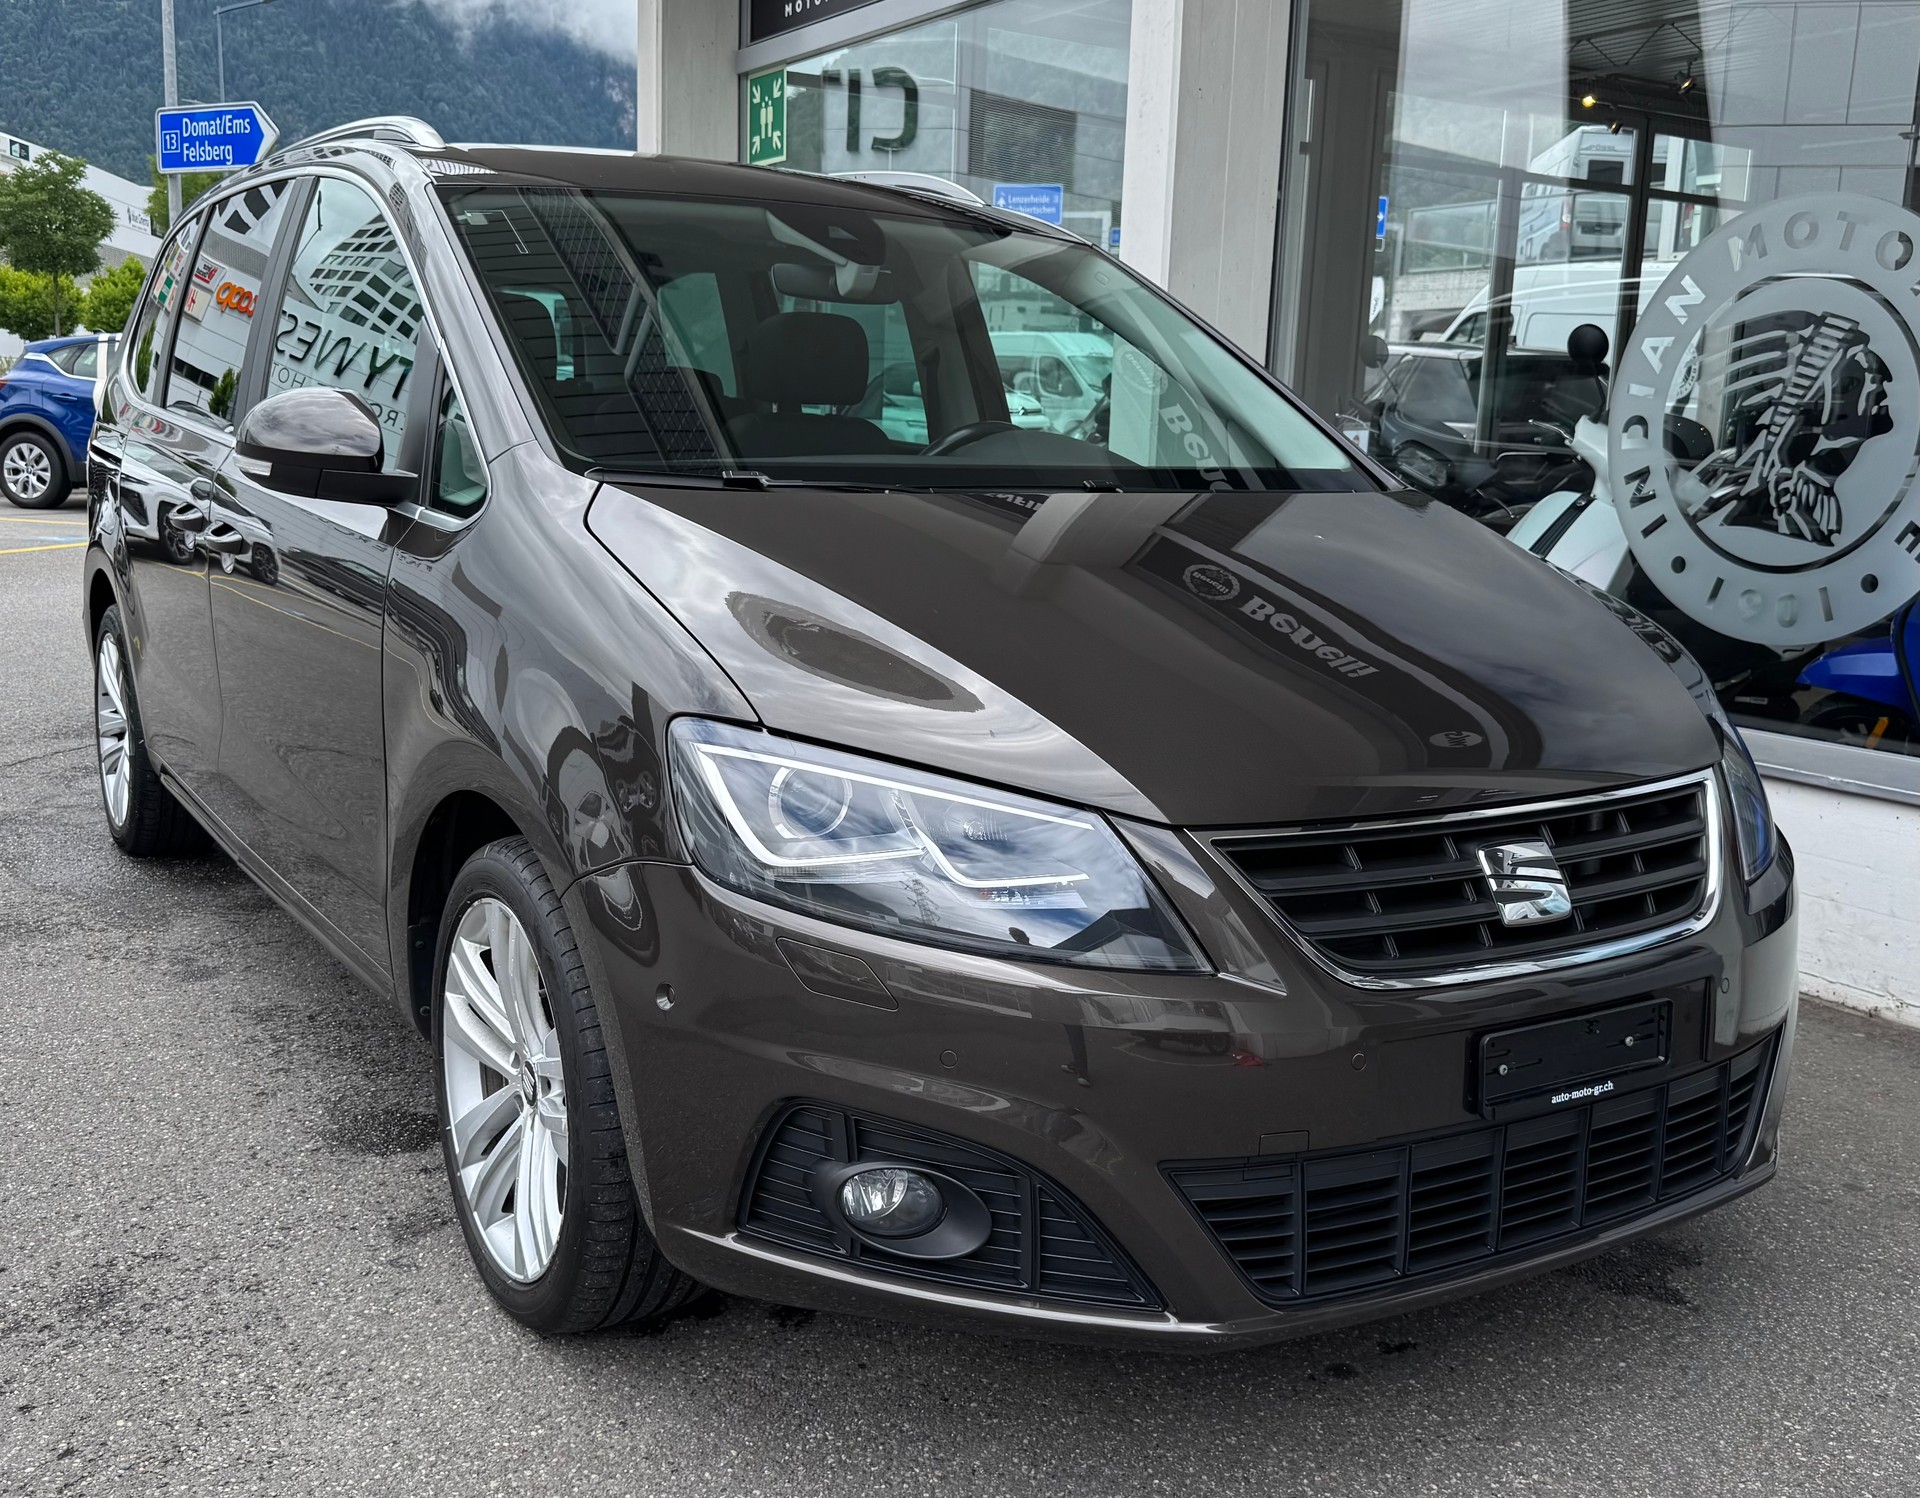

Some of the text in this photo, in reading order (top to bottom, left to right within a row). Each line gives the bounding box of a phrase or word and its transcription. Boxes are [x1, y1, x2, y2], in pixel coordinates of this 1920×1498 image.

[182, 115, 251, 137] Domat/Ems
[165, 134, 177, 150] 13
[183, 140, 233, 165] Felsberg
[1008, 194, 1050, 203] Lenzerheide
[1621, 211, 1920, 539] INDIAN MOTO
[1706, 576, 1834, 628] 1901
[1551, 1080, 1615, 1104] auto-moto-gr.ch
